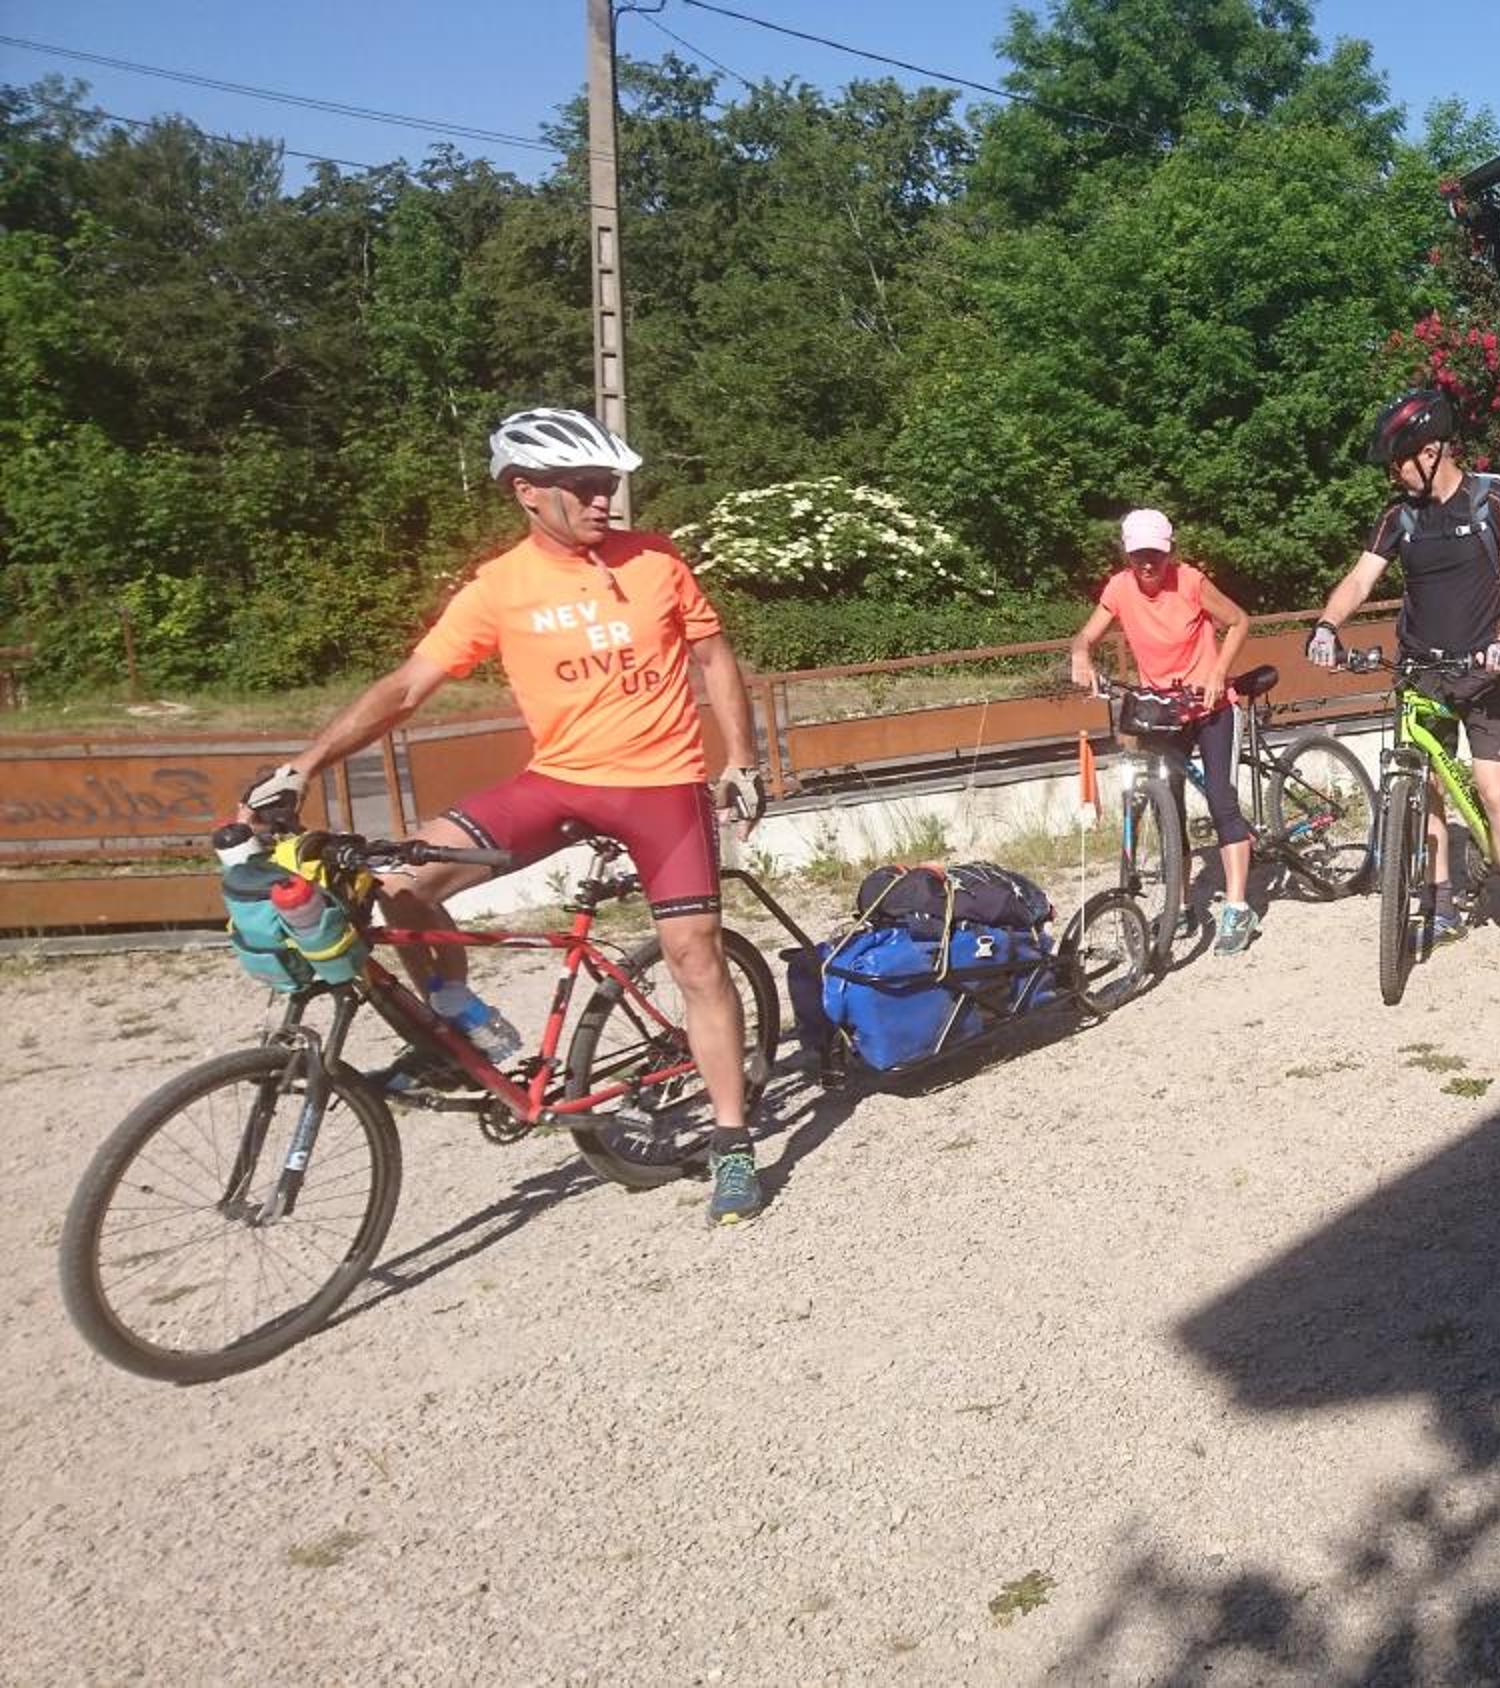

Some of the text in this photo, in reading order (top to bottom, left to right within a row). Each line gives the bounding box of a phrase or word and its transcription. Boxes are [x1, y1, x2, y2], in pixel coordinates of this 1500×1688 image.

[532, 601, 598, 633] NEV
[586, 621, 632, 650] ER
[556, 648, 637, 682] GIVE
[621, 670, 661, 696] UP
